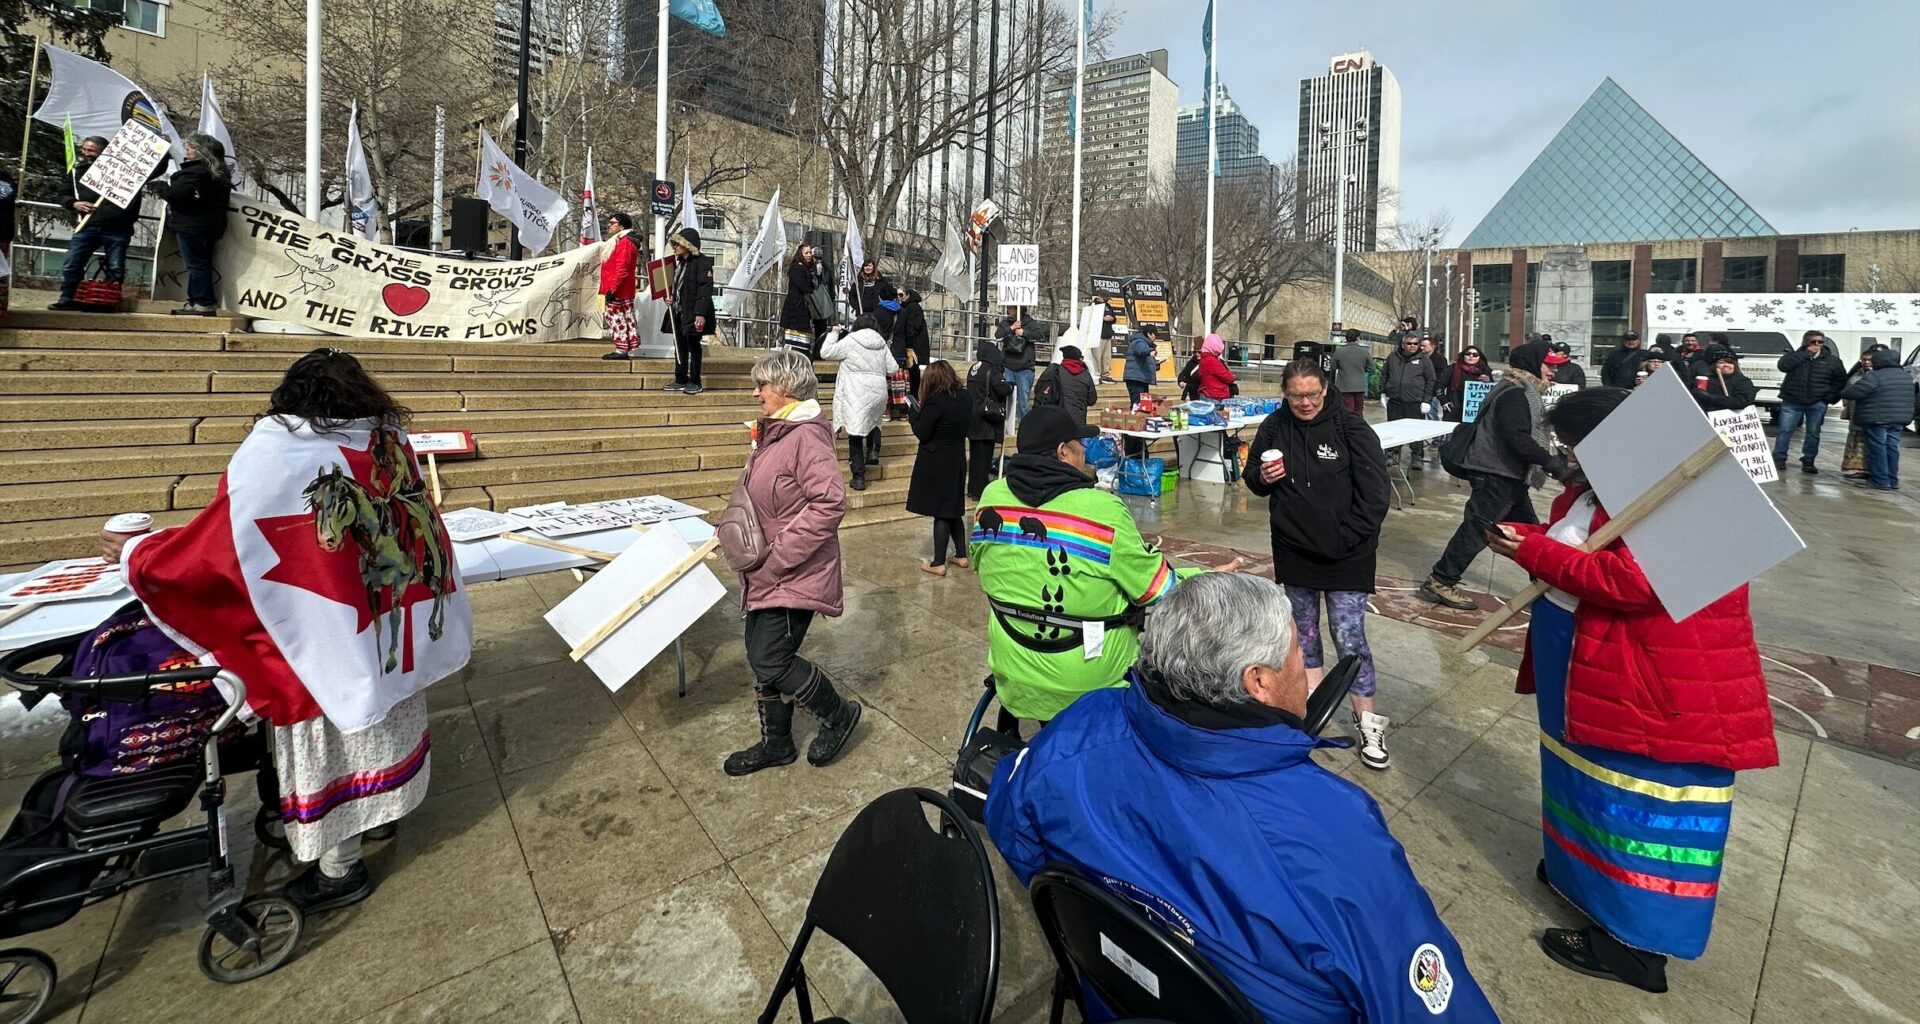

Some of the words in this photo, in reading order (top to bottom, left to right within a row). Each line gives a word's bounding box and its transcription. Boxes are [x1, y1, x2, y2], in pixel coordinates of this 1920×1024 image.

[1334, 57, 1363, 73] CN
[522, 210, 548, 232] ATION
[246, 218, 312, 250] THE
[332, 247, 432, 286] GRASS
[450, 273, 536, 291] GROWS
[316, 232, 357, 250] AS
[371, 248, 422, 269] THE
[436, 258, 565, 277] SUNSHINES
[999, 246, 1037, 264] LAND
[1094, 280, 1120, 288] DEFEND
[238, 288, 288, 311] AND
[305, 299, 357, 328] THE
[369, 316, 450, 339] RIVER
[464, 318, 538, 340] FLOWS
[1713, 416, 1743, 428] TREATY
[1729, 421, 1760, 433] HONOUR
[1742, 433, 1760, 441] THE
[1747, 464, 1773, 480] HON
[1018, 610, 1045, 621] Evolution
